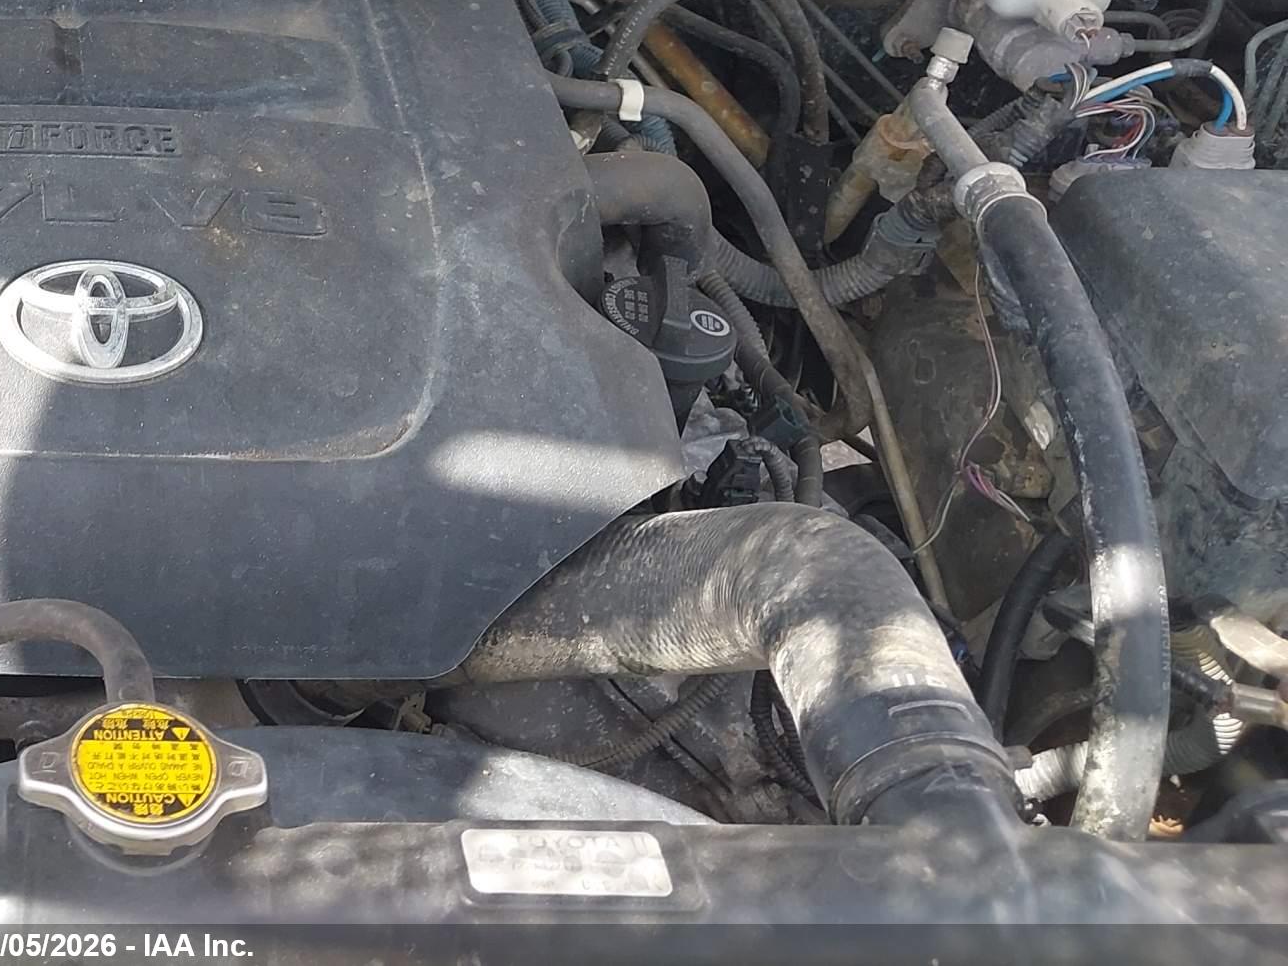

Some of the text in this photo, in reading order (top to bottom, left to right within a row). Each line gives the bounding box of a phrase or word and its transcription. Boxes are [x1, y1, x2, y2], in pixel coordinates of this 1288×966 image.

[142, 184, 329, 238] V8
[93, 729, 165, 740] ATTENTION
[145, 772, 169, 780] OPEN
[106, 793, 176, 804] CAUTION
